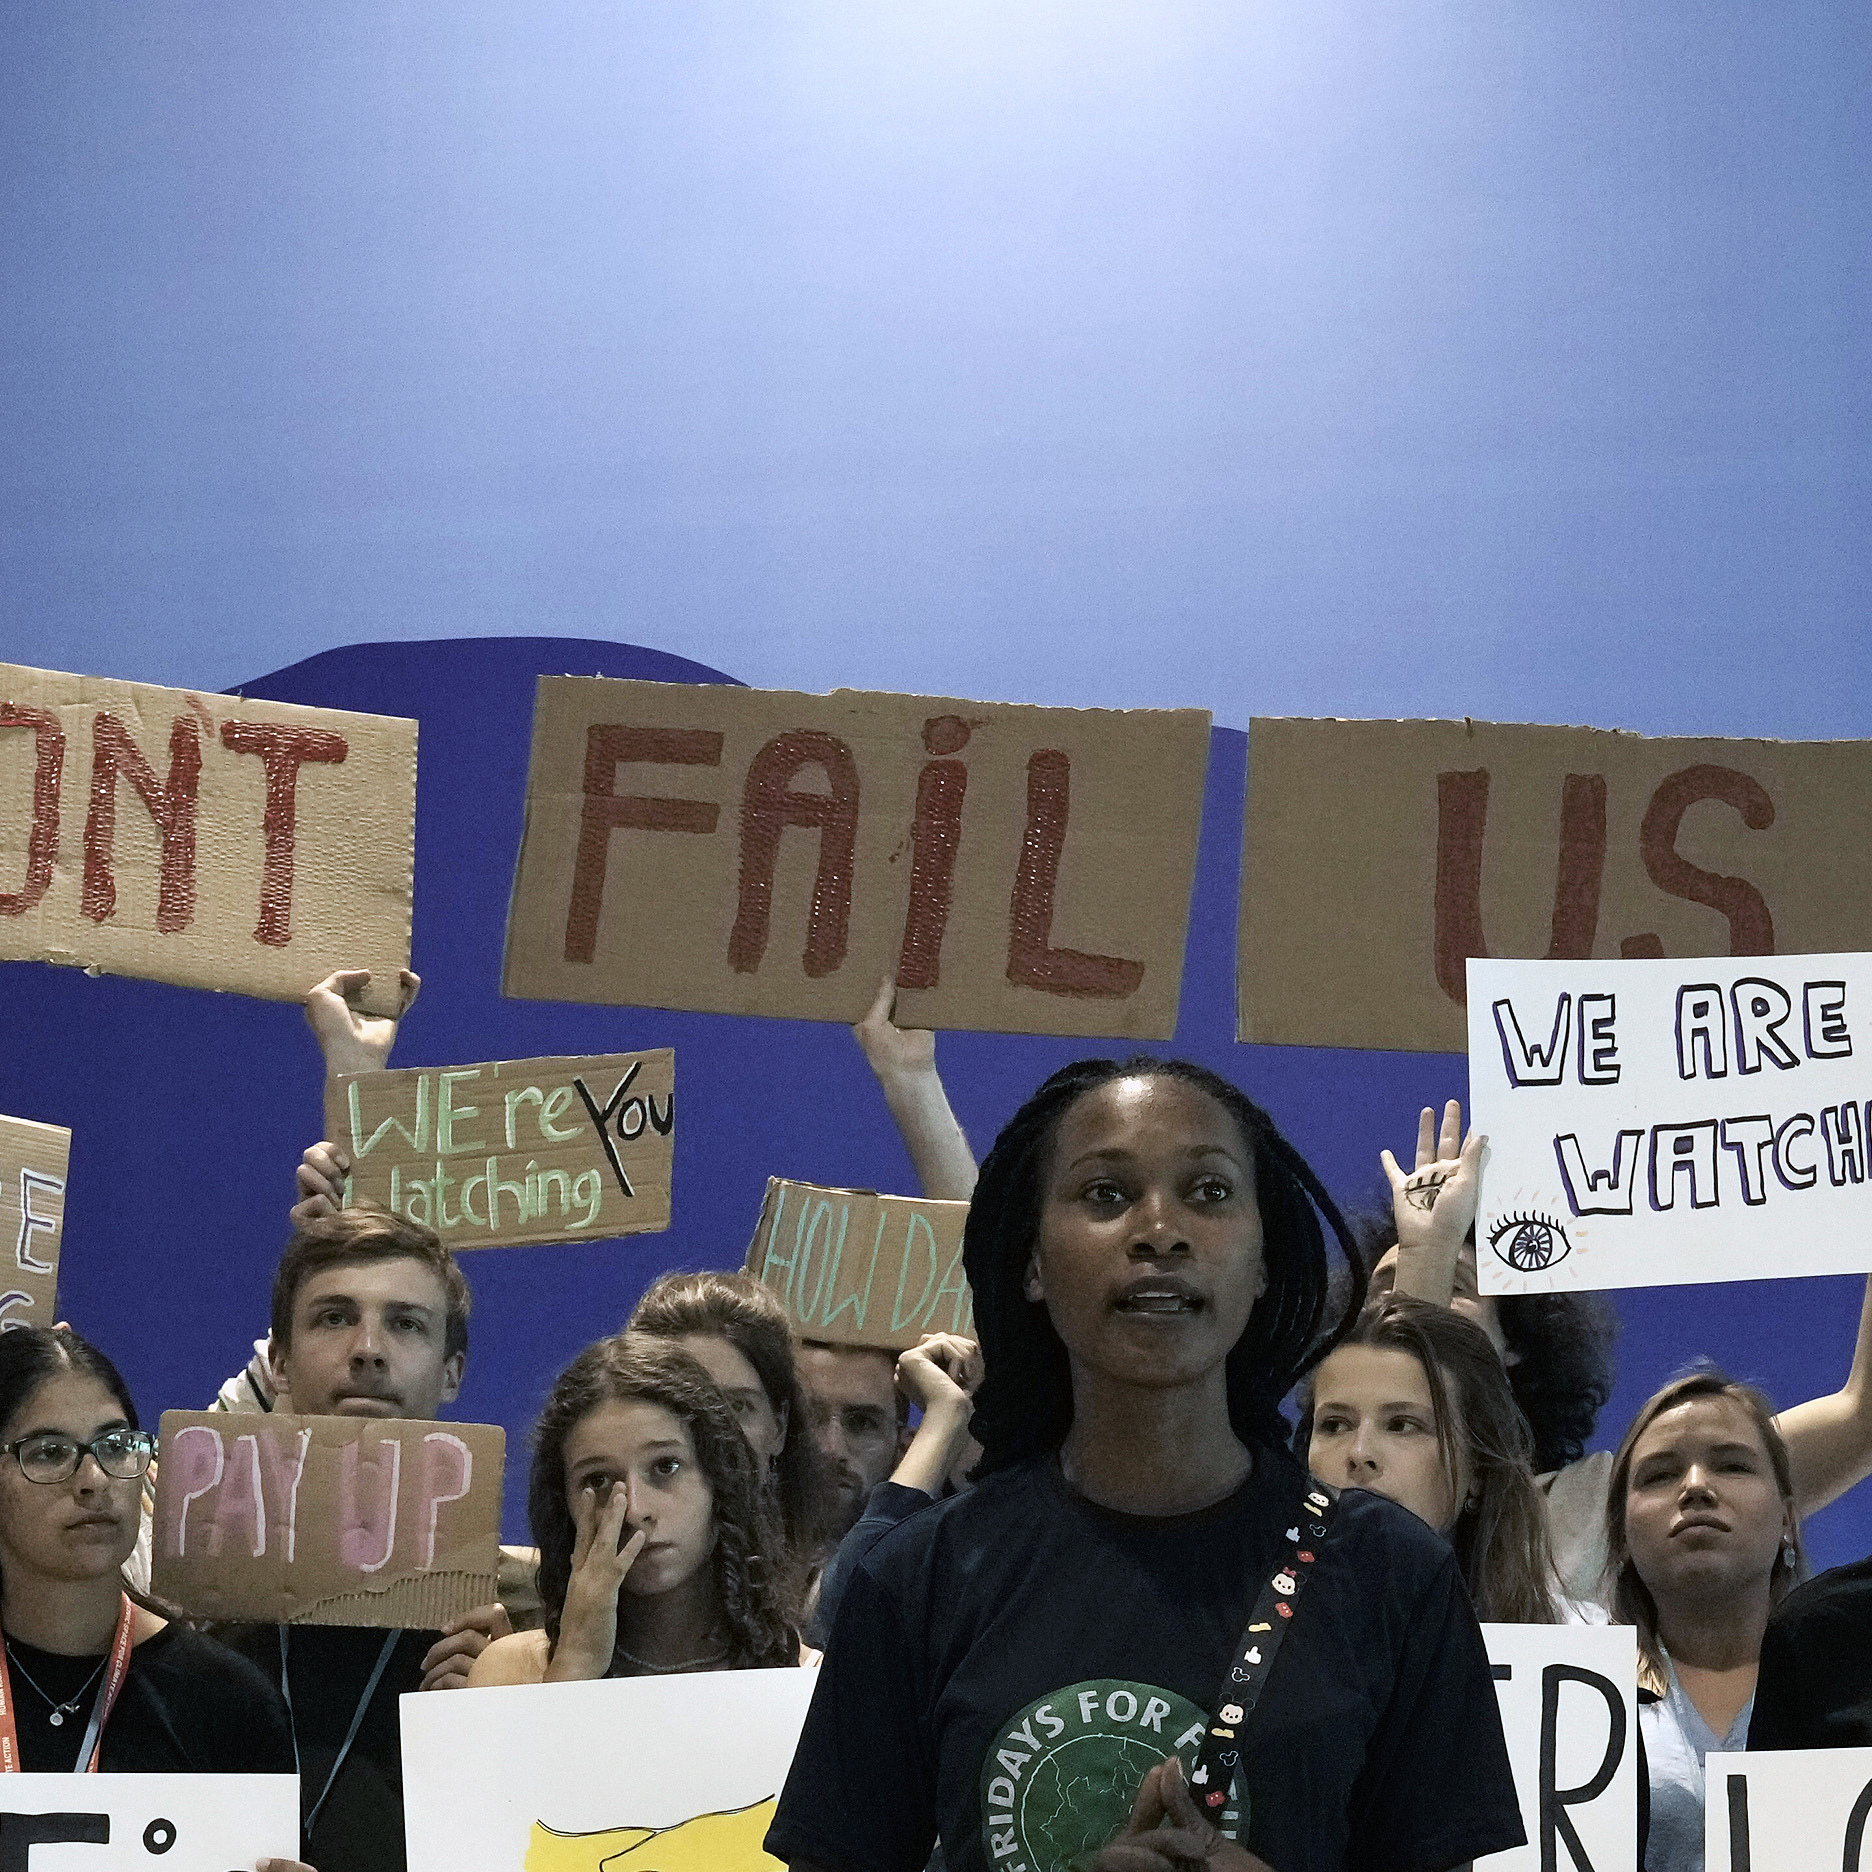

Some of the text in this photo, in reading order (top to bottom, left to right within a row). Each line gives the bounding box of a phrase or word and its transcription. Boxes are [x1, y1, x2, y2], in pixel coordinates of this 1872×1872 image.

[1434, 764, 1776, 1010] US
[1492, 977, 1853, 1089] WE ARE
[761, 1190, 973, 1333] HOW DA
[165, 1426, 473, 1572] PAY UP
[3, 1736, 12, 1763] ACTION
[1078, 1690, 1171, 1733] FOR
